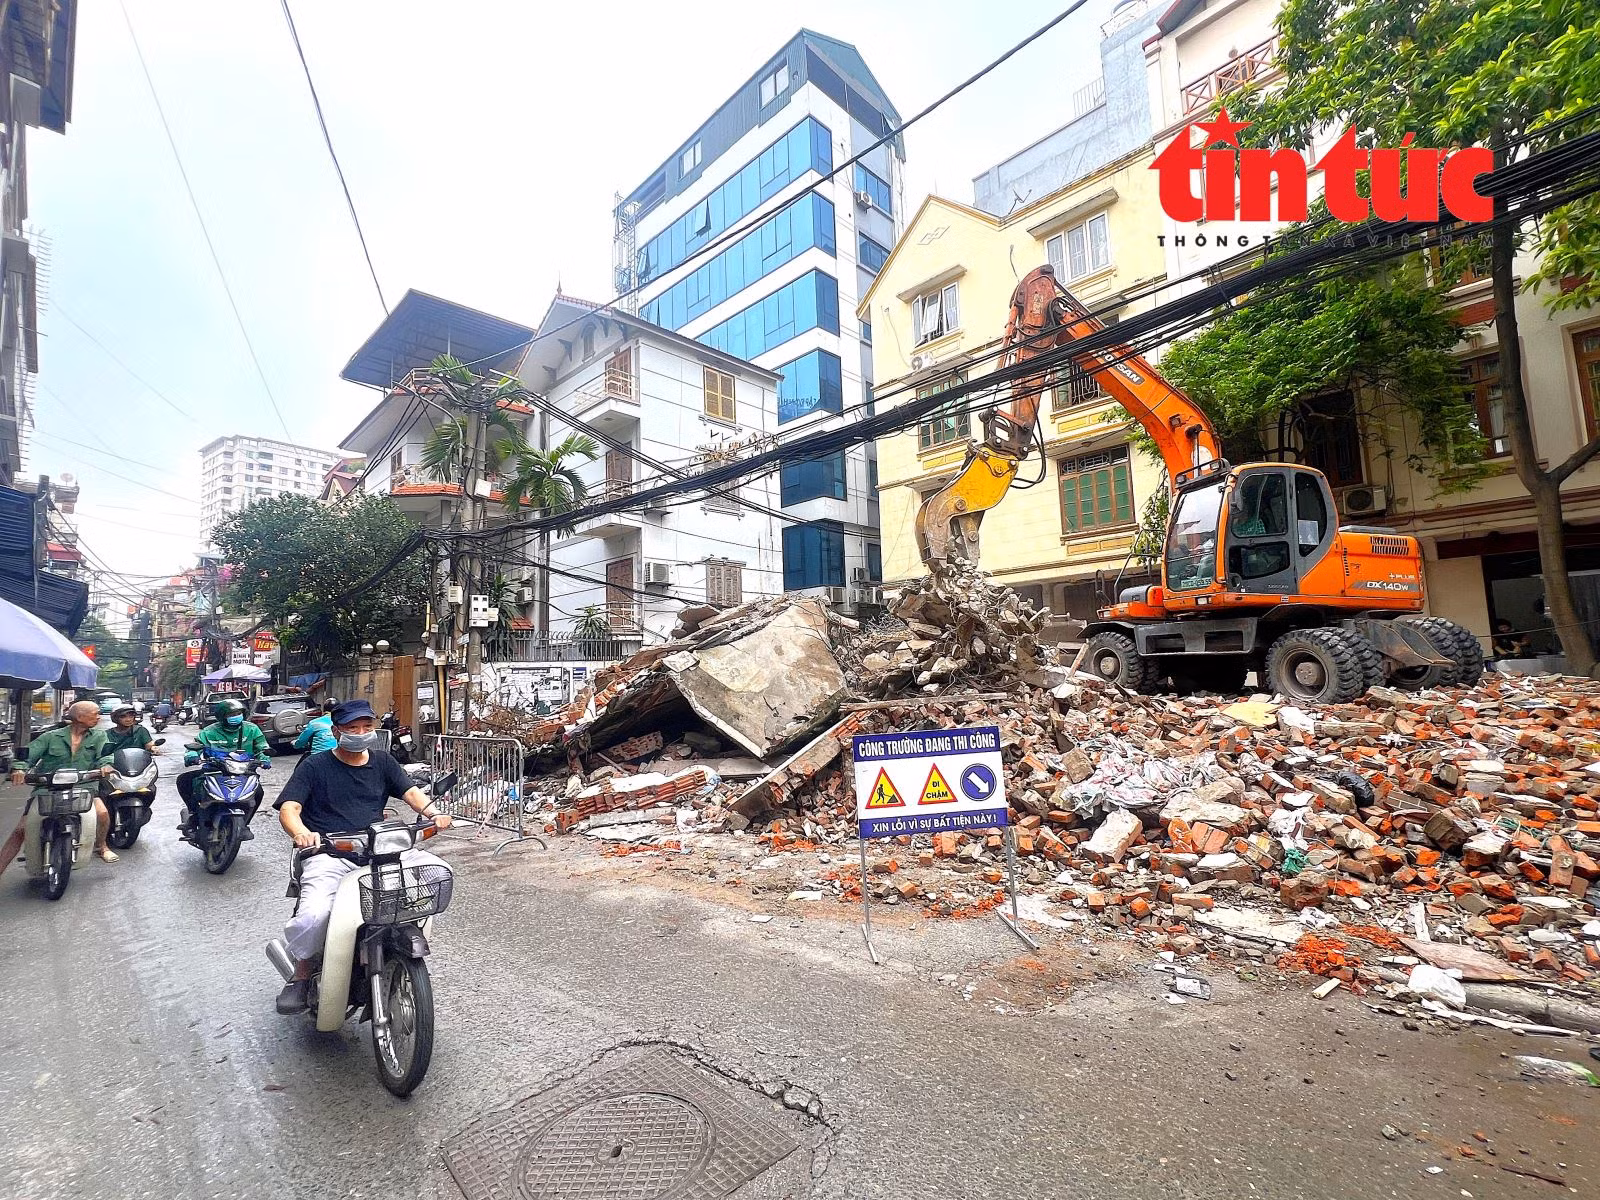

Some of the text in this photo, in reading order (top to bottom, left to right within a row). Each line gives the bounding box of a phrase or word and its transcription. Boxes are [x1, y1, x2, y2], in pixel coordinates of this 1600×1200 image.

[858, 731, 996, 757] CÔNG TRƯỜNG ĐANG THI CÔNG
[926, 790, 949, 800] CHẬM
[872, 823, 889, 833] XIN
[909, 818, 918, 830] VÌ
[919, 818, 932, 831] SỰ
[933, 815, 951, 828] BẤT
[952, 814, 971, 828] TIỆN
